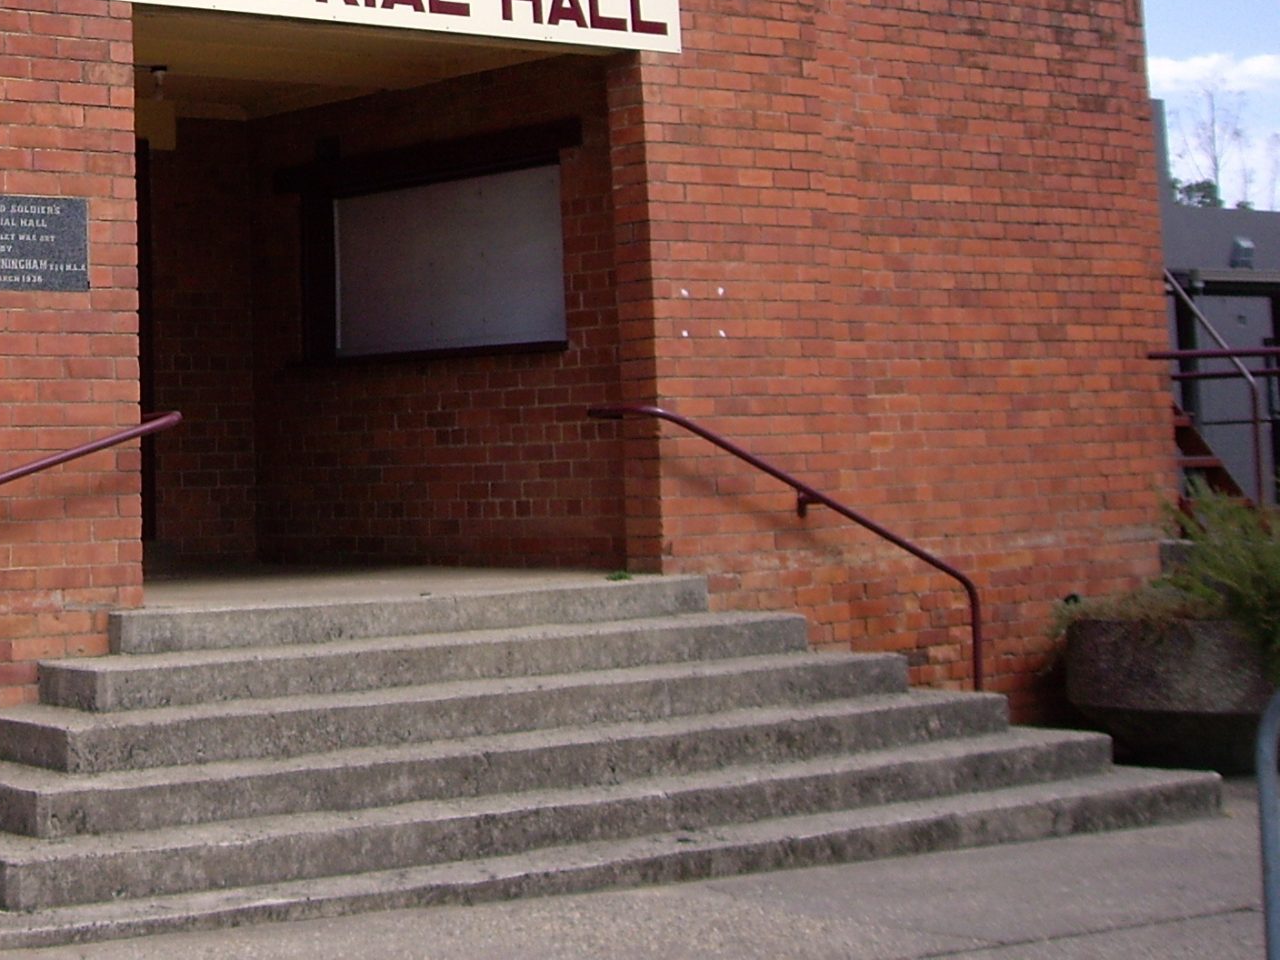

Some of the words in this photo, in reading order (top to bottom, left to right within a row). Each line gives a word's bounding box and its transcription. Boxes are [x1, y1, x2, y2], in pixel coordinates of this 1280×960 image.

[20, 218, 48, 228] HALL
[18, 233, 37, 241] WAS
[0, 244, 13, 253] BY
